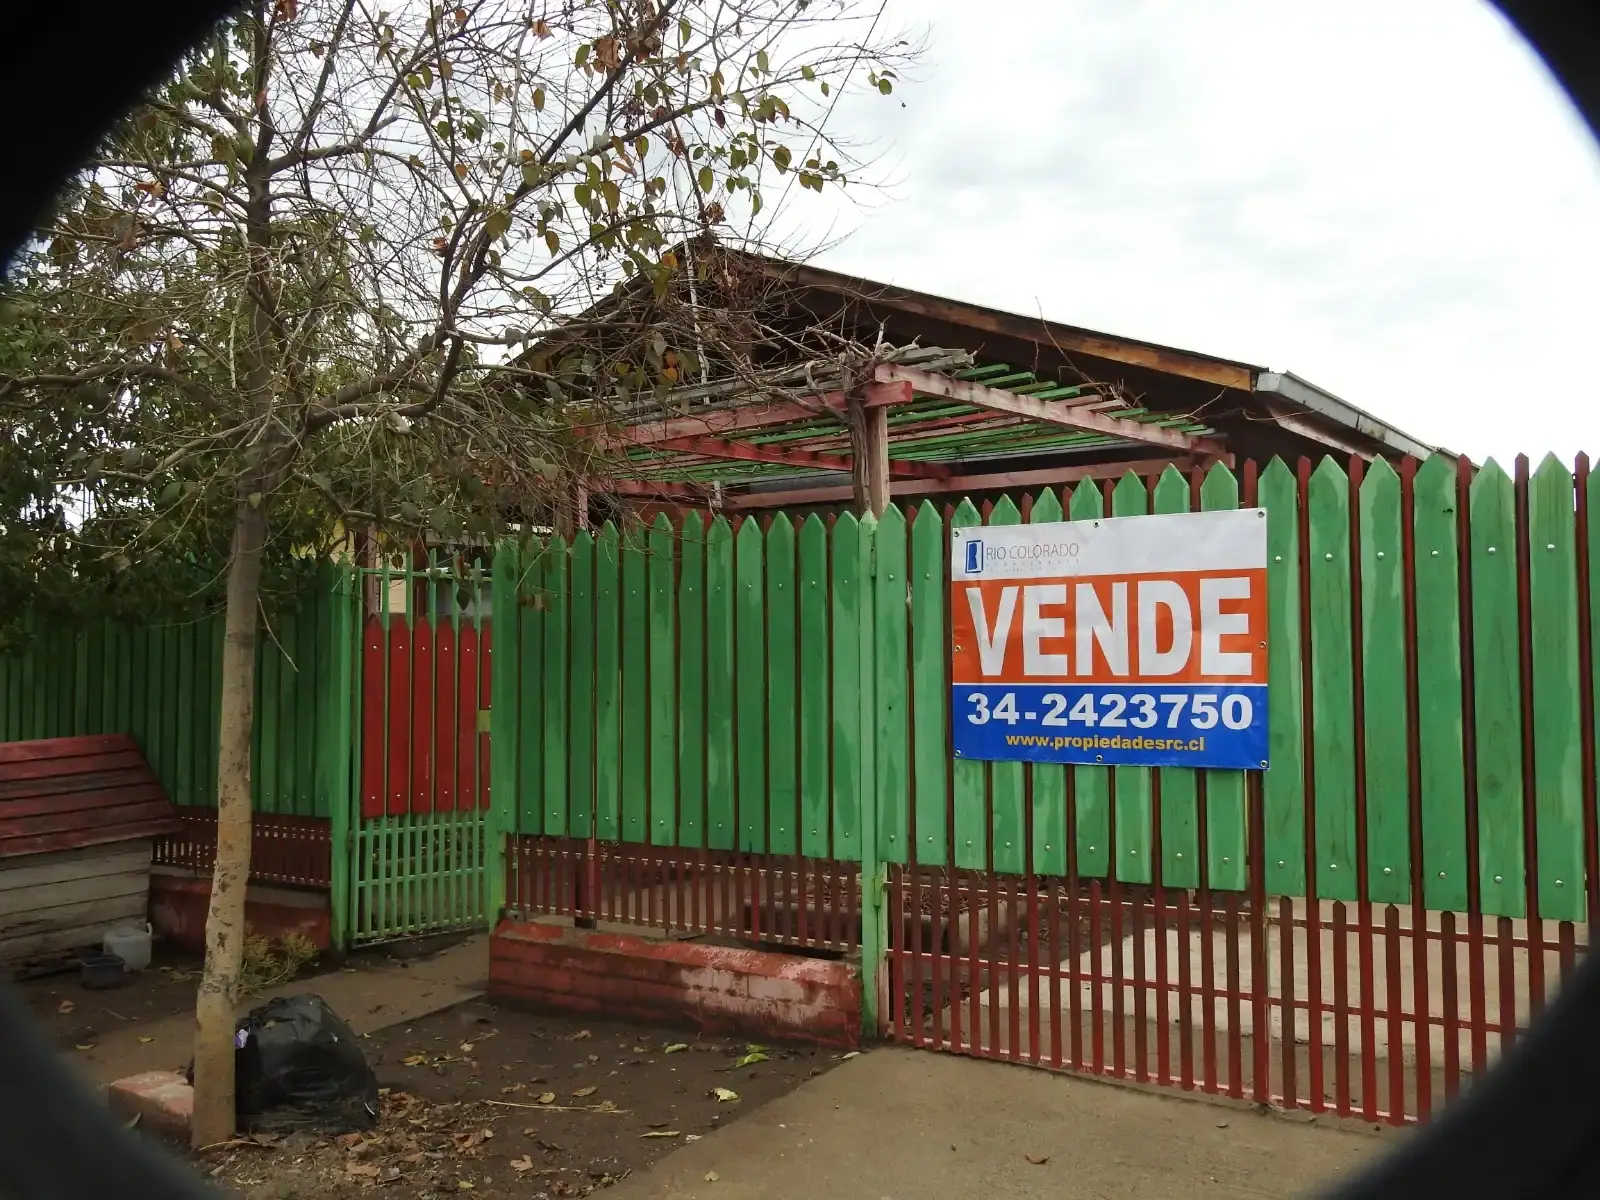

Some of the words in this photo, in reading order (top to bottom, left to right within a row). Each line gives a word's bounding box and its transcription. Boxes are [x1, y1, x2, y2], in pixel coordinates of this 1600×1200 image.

[986, 546, 1007, 561] RIO
[1009, 542, 1079, 560] COLORADO
[965, 577, 1253, 677] VENDE
[967, 692, 1253, 730] 34-2423750
[1005, 734, 1205, 752] www.propiedadesrc.cl
